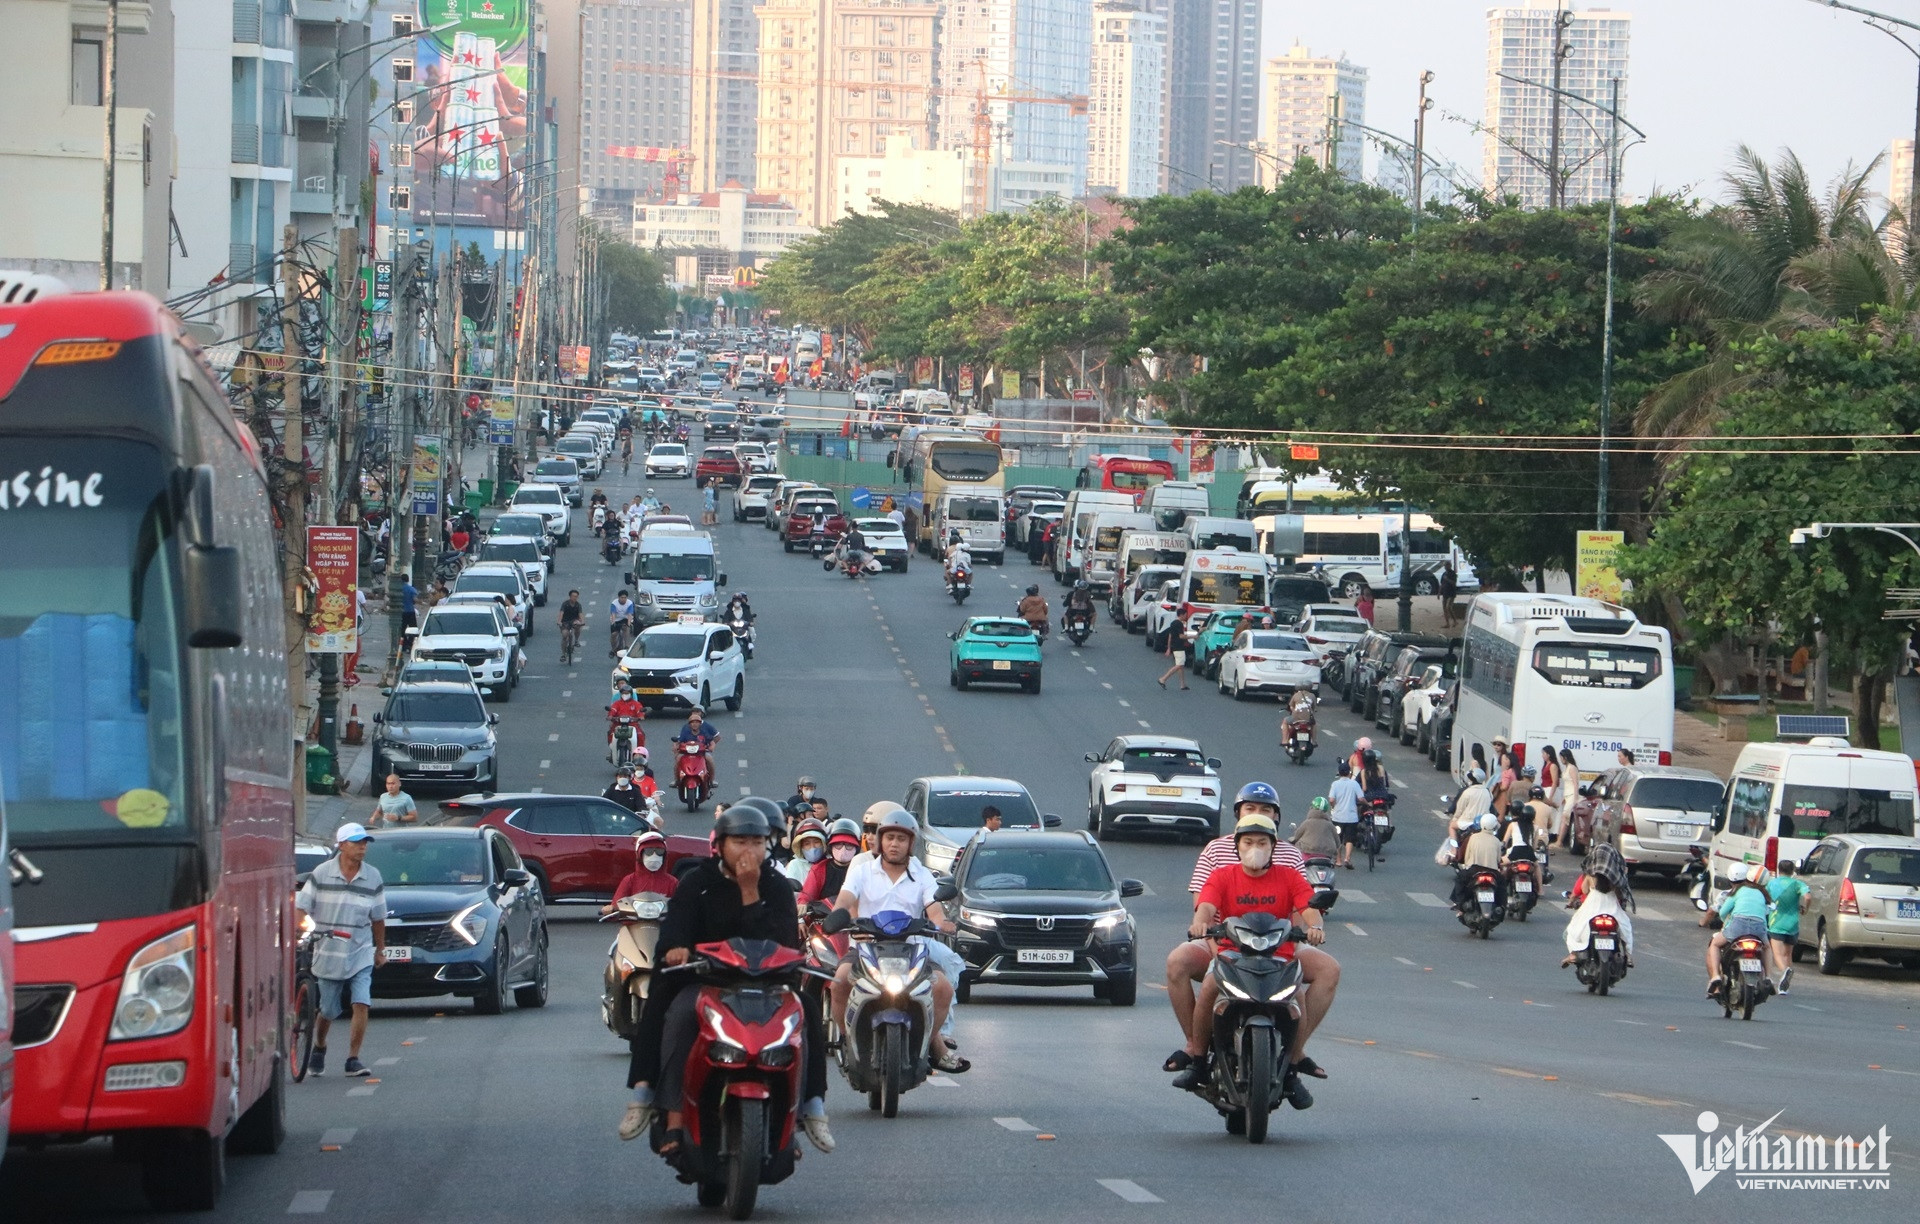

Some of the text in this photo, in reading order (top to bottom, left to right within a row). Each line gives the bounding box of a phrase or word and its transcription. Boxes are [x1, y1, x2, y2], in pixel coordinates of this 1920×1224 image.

[471, 12, 505, 20] Heineken
[377, 264, 391, 274] GS
[377, 273, 391, 282] 25
[1131, 462, 1149, 471] VIP
[1562, 740, 1581, 750] 60H
[1591, 741, 1623, 752] 129.09
[1022, 952, 1069, 961] 51M-406.97
